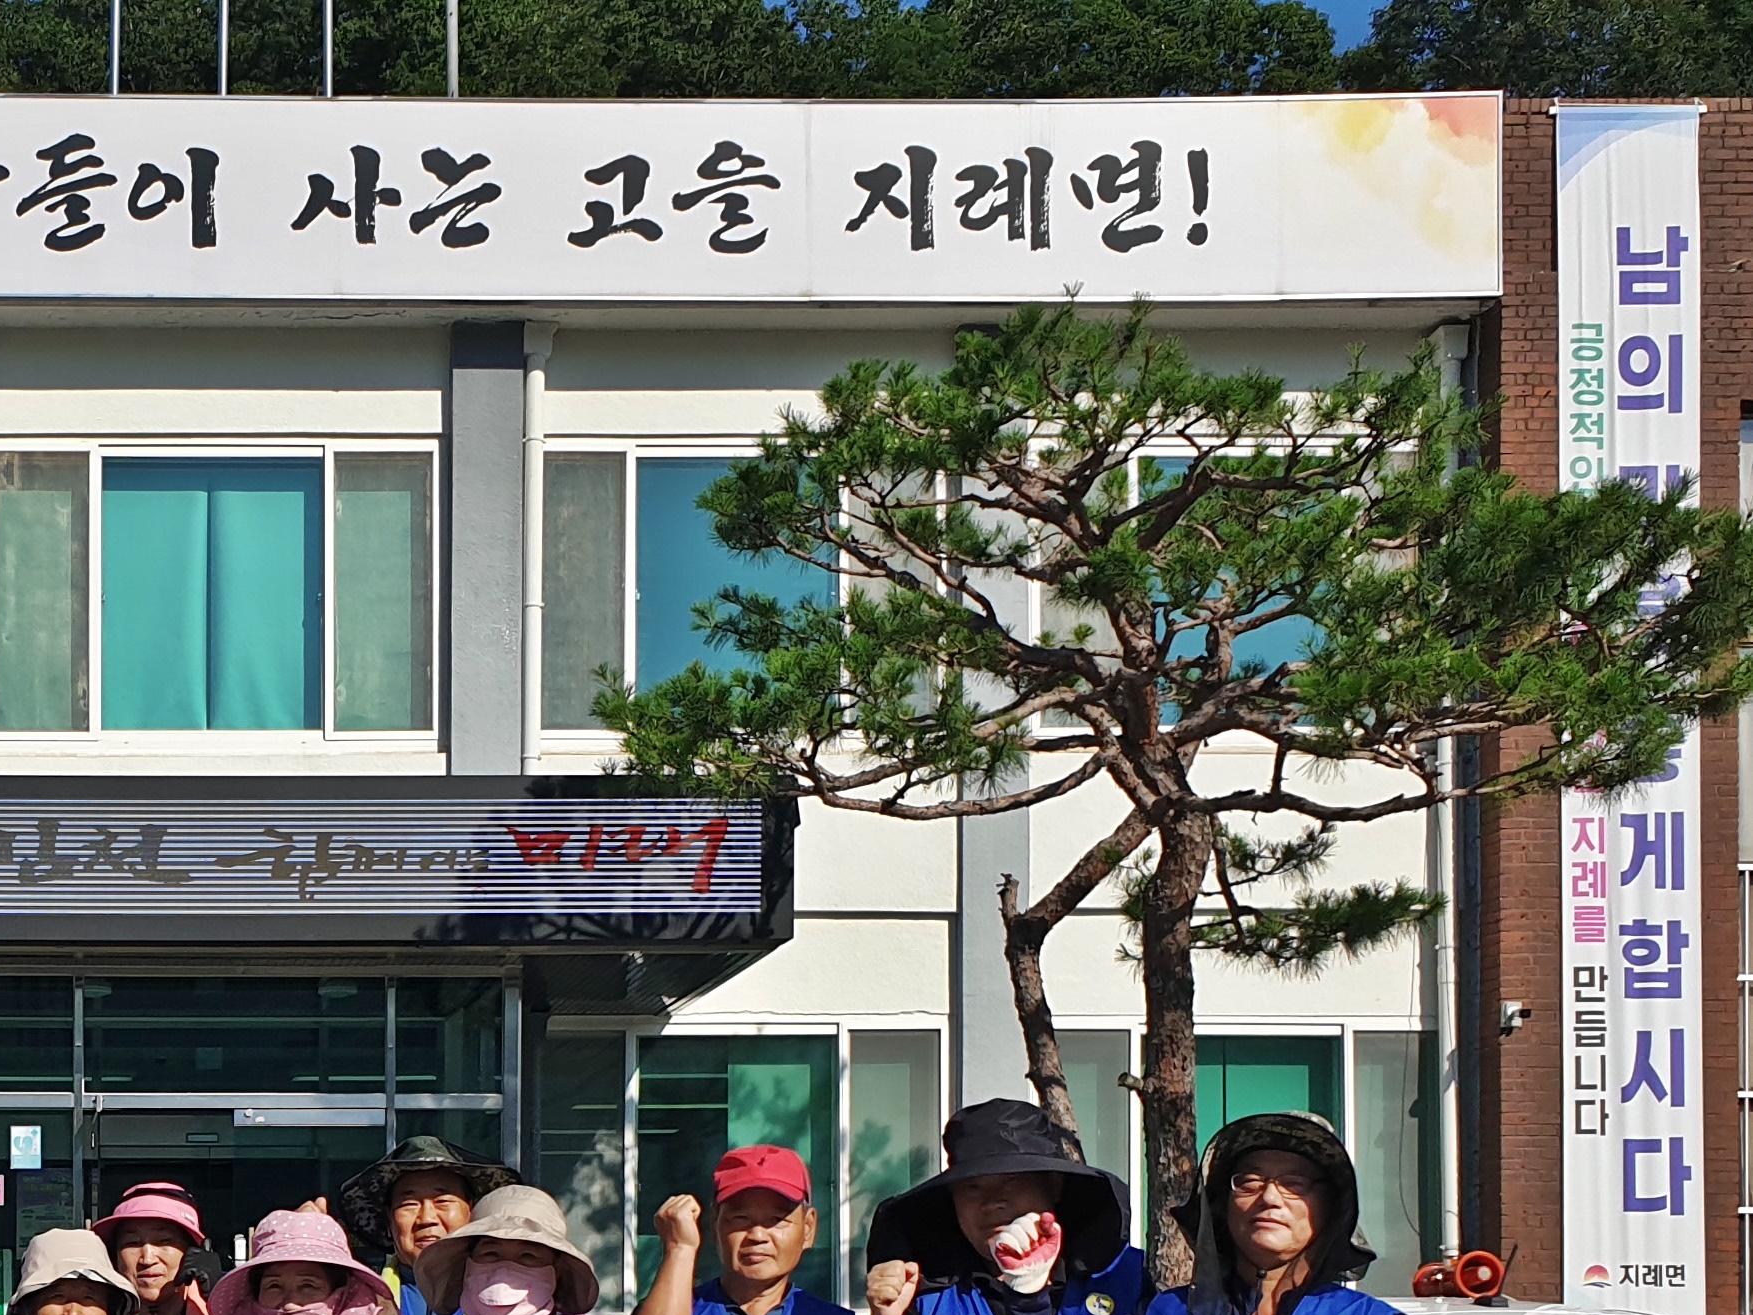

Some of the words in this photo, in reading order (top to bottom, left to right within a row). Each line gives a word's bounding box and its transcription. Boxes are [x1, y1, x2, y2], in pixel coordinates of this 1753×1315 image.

[290, 144, 502, 249] 사는
[567, 140, 781, 254] 고을
[845, 140, 1210, 253] 지례면!
[1616, 226, 1688, 414] 남의
[1571, 817, 1606, 943] 지례를
[1573, 966, 1609, 1137] 만듭니다
[1619, 1263, 1686, 1288] 지례면
